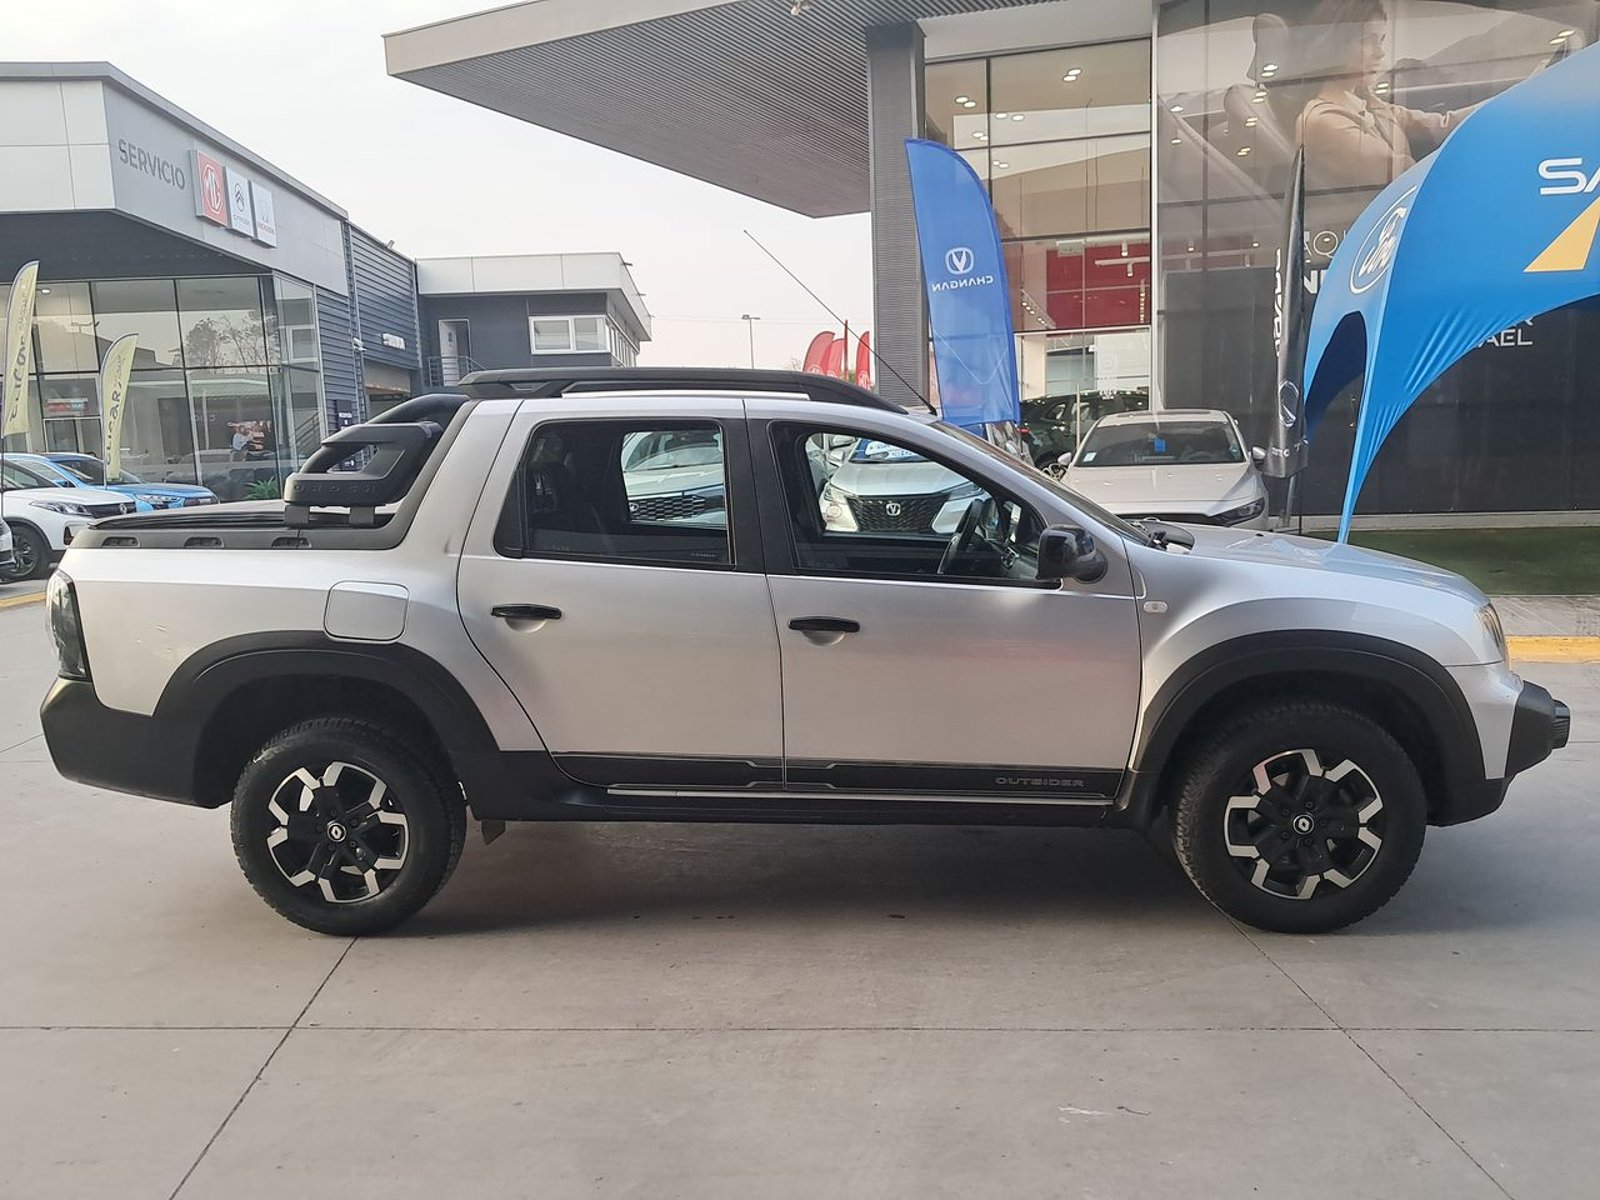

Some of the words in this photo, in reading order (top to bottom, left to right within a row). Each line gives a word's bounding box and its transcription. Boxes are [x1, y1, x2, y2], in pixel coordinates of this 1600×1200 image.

[118, 139, 186, 190] SERVICIO
[1538, 157, 1600, 195] S
[995, 776, 1084, 787] OUTSIDER
